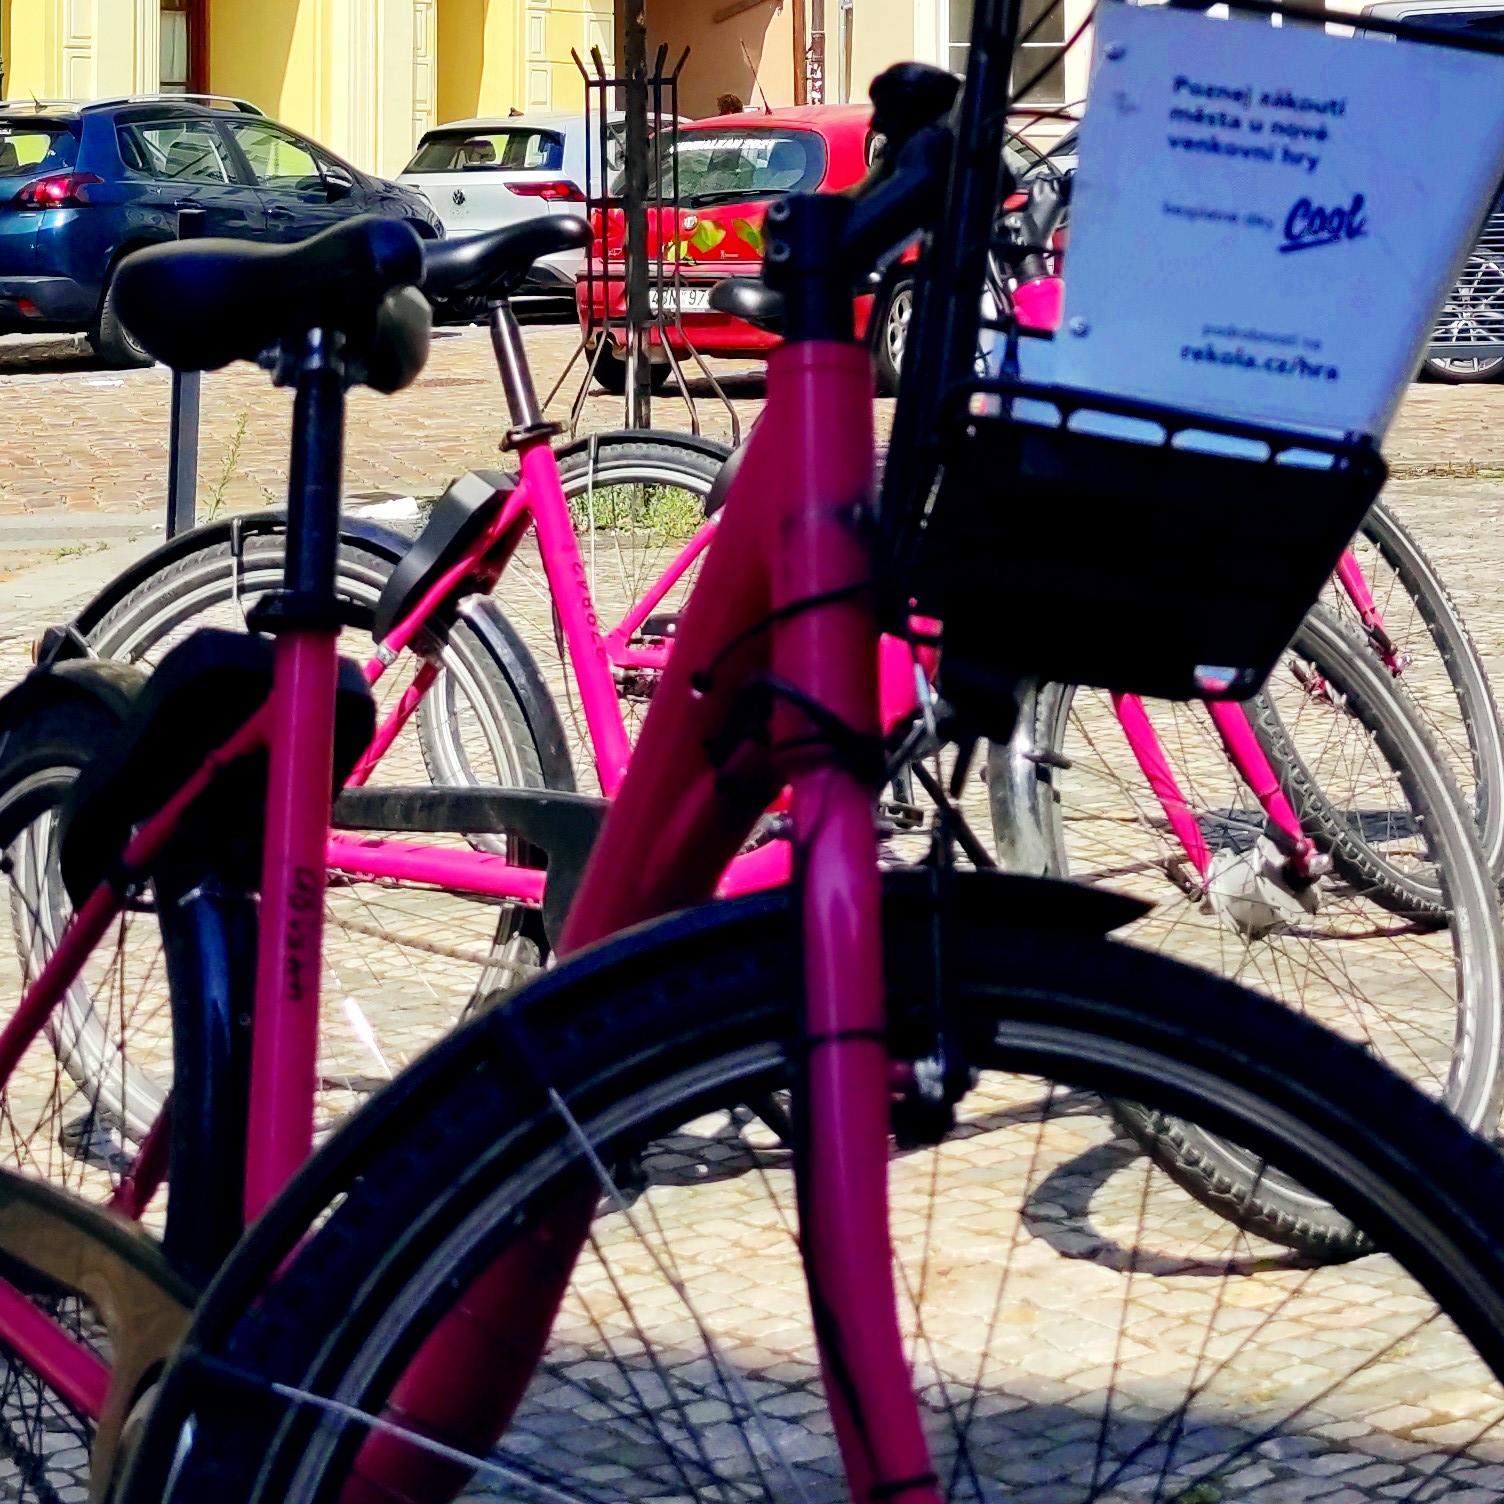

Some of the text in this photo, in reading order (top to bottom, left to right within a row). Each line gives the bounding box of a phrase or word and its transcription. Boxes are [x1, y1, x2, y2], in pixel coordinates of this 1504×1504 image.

[1172, 75, 1253, 110] Poznej
[1169, 105, 1242, 130] města
[1280, 144, 1321, 174] hry
[1280, 192, 1368, 246] Cool
